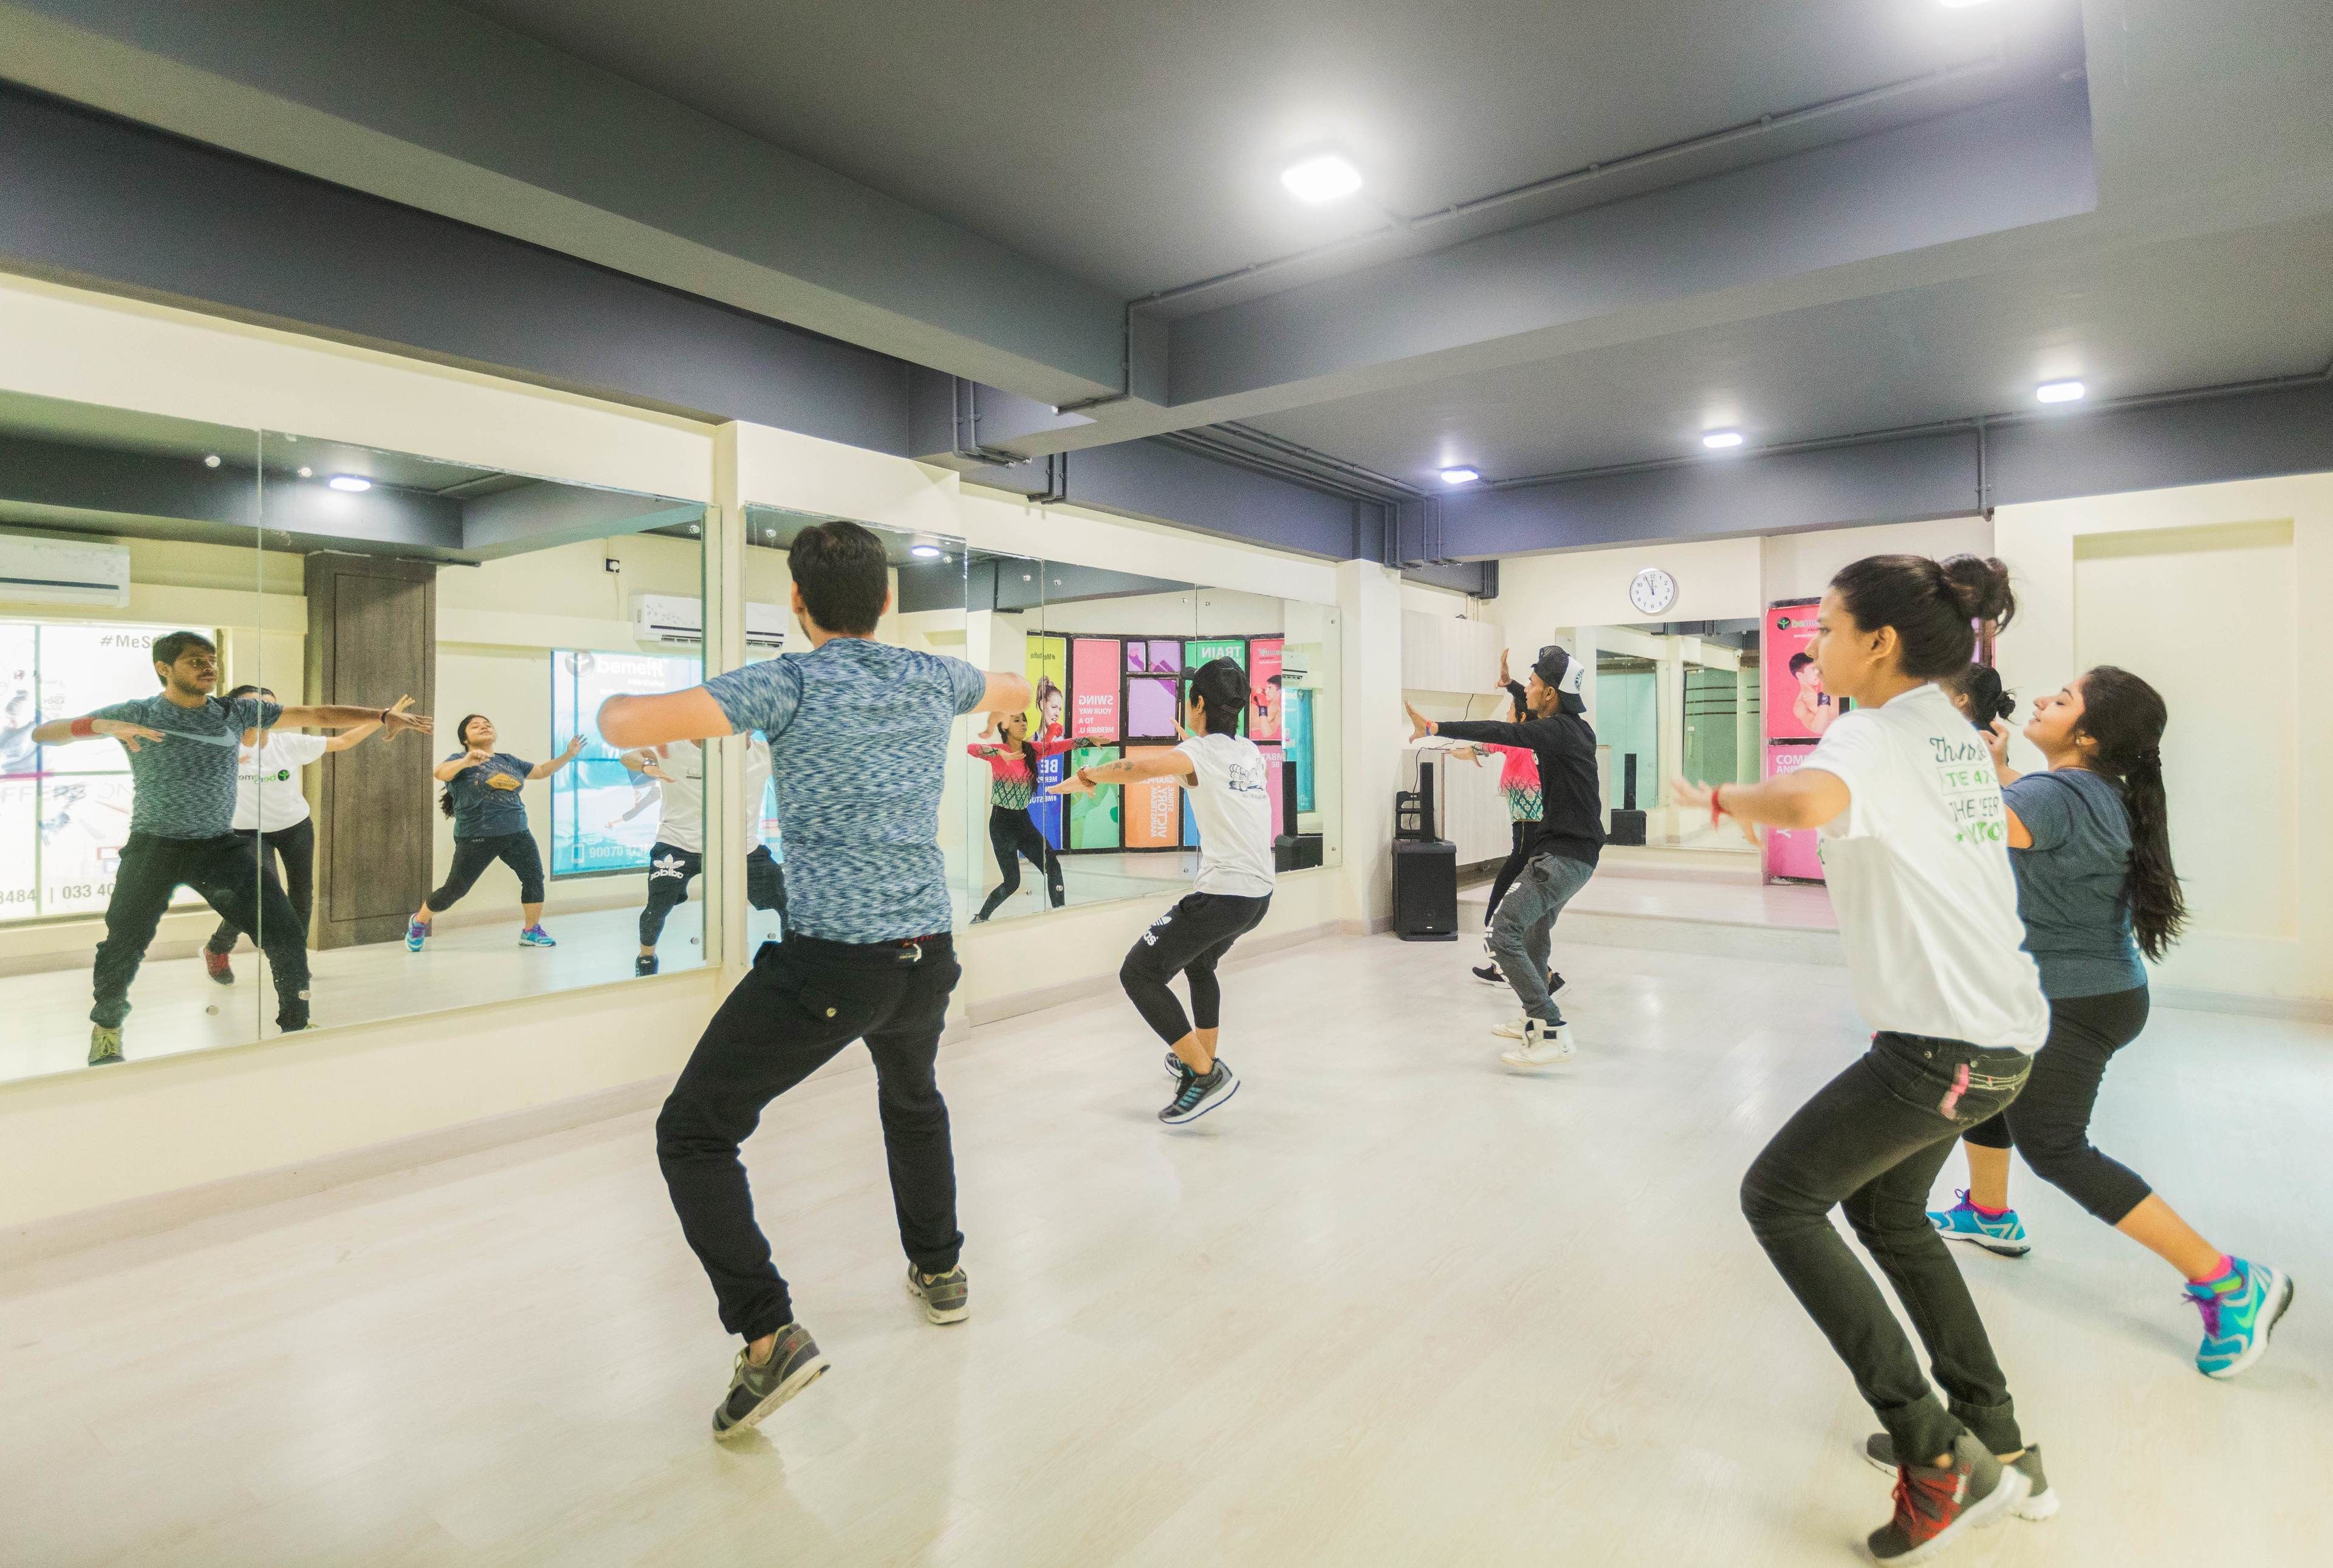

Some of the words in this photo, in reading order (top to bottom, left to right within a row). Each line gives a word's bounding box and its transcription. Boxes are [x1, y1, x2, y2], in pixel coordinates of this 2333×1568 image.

[100, 634, 152, 649] #MeS
[589, 846, 623, 858] 90070
[63, 885, 91, 899] 033
